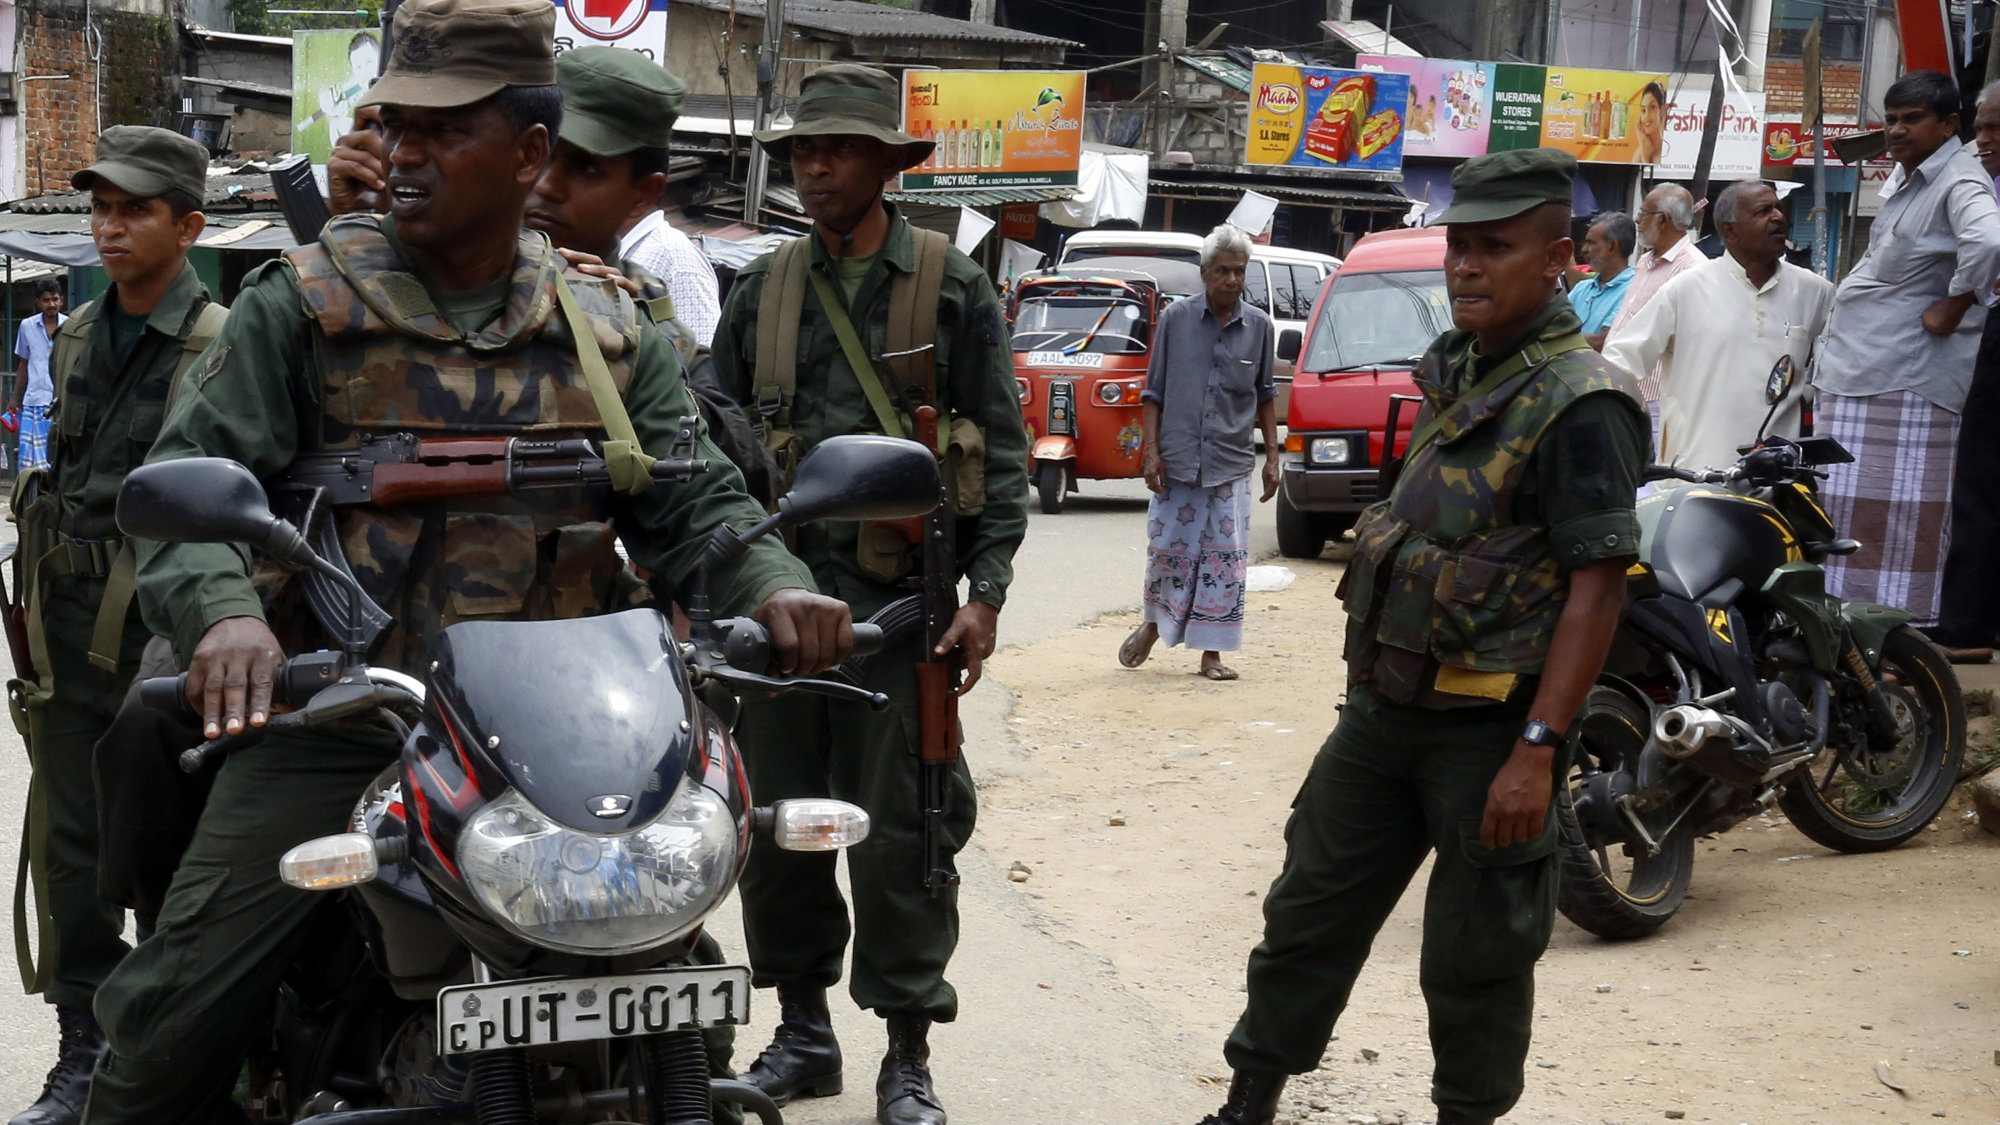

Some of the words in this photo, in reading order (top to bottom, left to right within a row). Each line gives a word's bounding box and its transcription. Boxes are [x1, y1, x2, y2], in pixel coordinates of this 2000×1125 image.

[1309, 77, 1326, 87] new
[1495, 91, 1542, 104] WIJERATHNA
[1502, 105, 1532, 117] STORES
[1271, 130, 1290, 141] Stores
[933, 175, 958, 186] FANCY
[958, 174, 978, 185] KADE
[1069, 353, 1102, 366] 3097
[502, 980, 739, 1045] UT-0011
